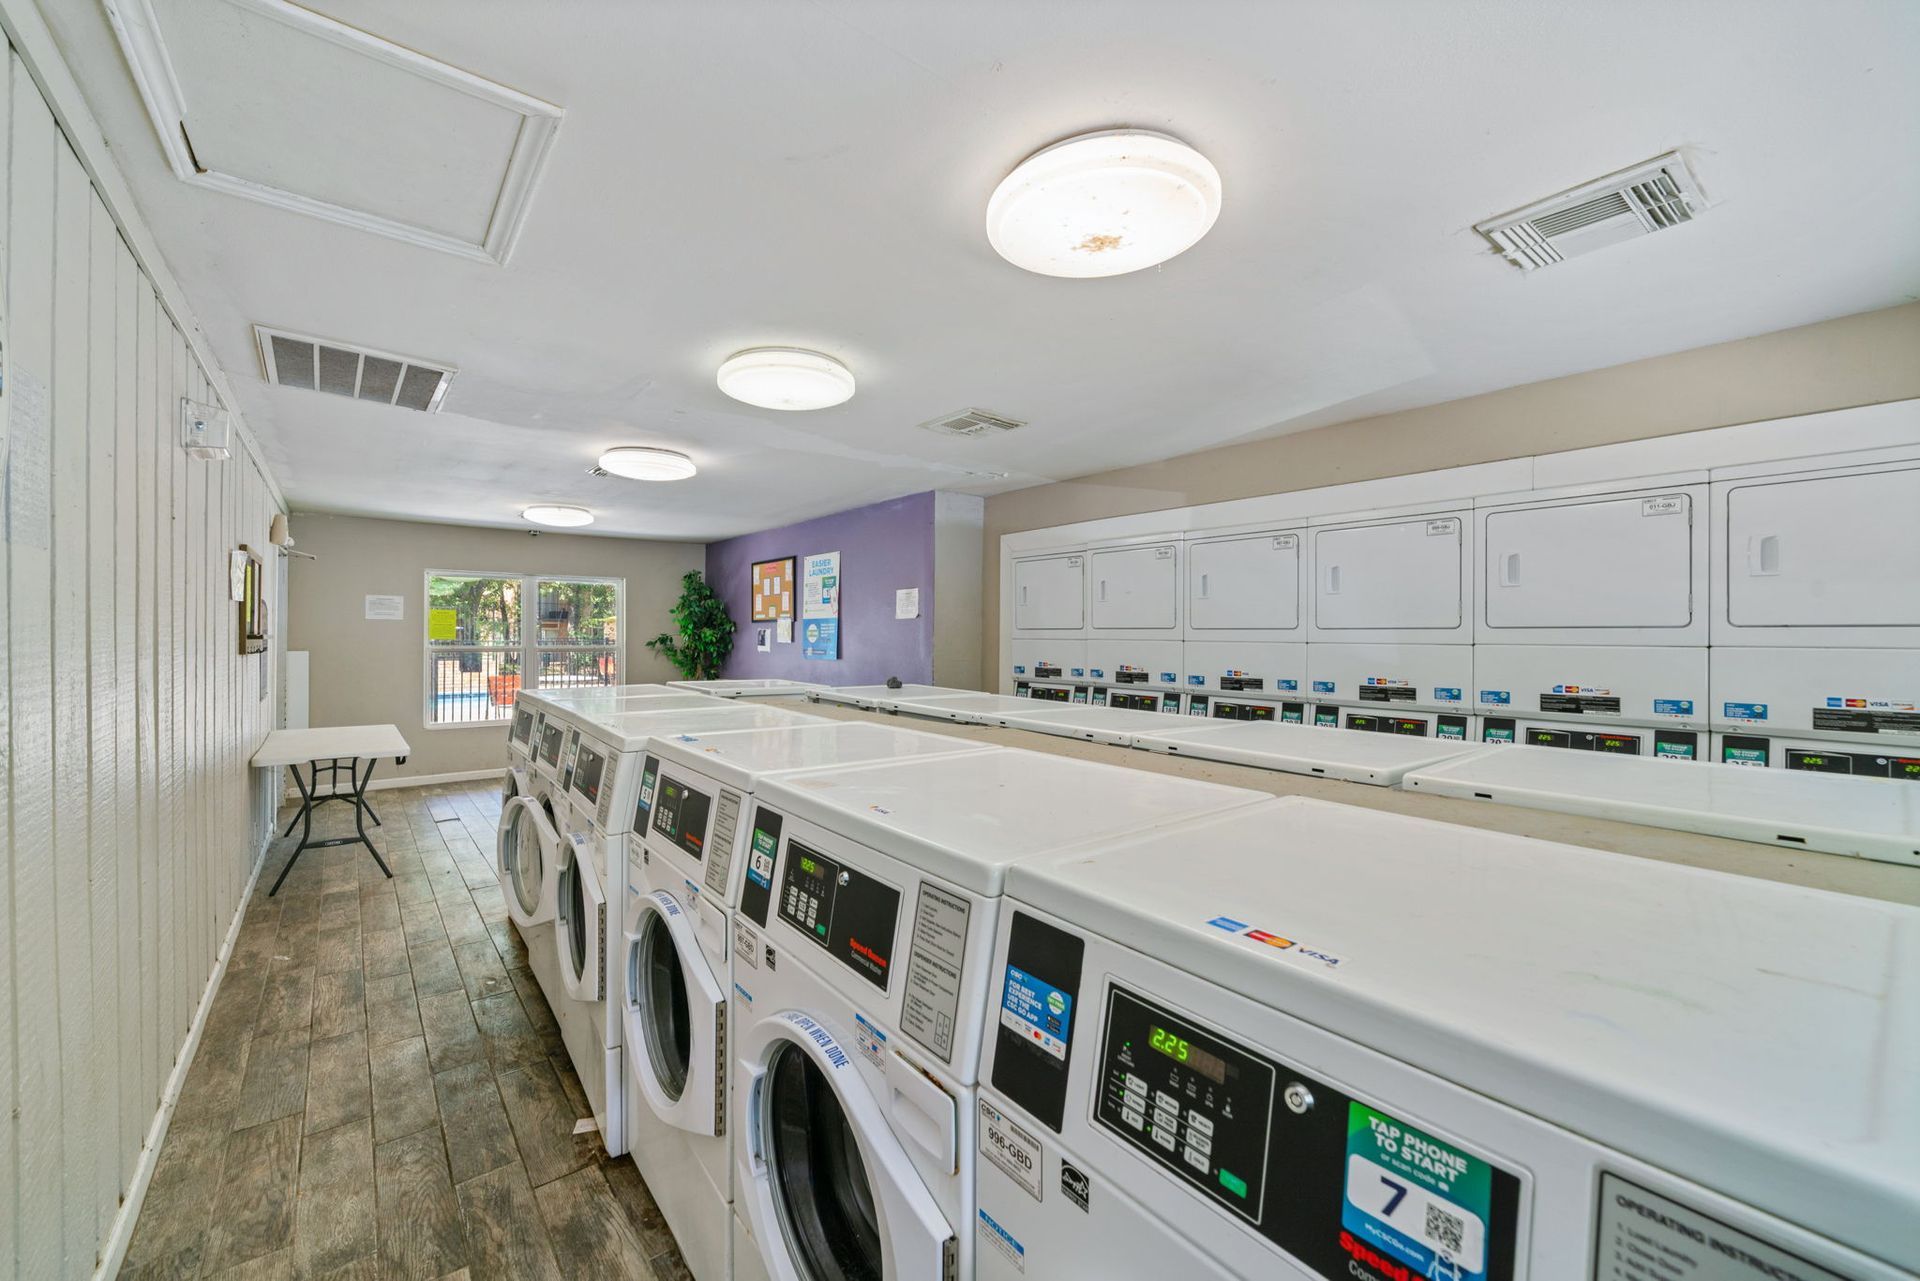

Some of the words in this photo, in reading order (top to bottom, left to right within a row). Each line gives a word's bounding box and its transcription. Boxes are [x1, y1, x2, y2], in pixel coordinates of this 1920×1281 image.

[809, 567, 833, 577] LAUNDRY
[812, 559, 832, 568] EASIER
[756, 856, 761, 869] 6
[1299, 947, 1340, 965] VISA
[1008, 980, 1022, 992] FOR
[1021, 985, 1036, 998] BEST
[1008, 986, 1042, 1011] EXPERIENCE
[1017, 1006, 1028, 1016] GO
[1027, 1010, 1039, 1022] APP
[1019, 999, 1030, 1011] THE
[809, 1026, 834, 1048] WHEN
[825, 1045, 850, 1069] DONE
[1152, 1028, 1189, 1061] 2.25
[981, 1103, 996, 1121] CSC
[987, 1126, 1033, 1171] 996-GBD
[1368, 1115, 1401, 1140] TAP
[1403, 1132, 1468, 1175] PHONE
[1374, 1131, 1398, 1153] TO
[1400, 1144, 1460, 1183] START
[1391, 1158, 1412, 1174] scan
[1412, 1169, 1436, 1186] code
[1380, 1175, 1408, 1217] 7
[1615, 1193, 1706, 1245] OPERATING
[1340, 1231, 1409, 1281] Speed
[1653, 1240, 1698, 1268] Laundry
